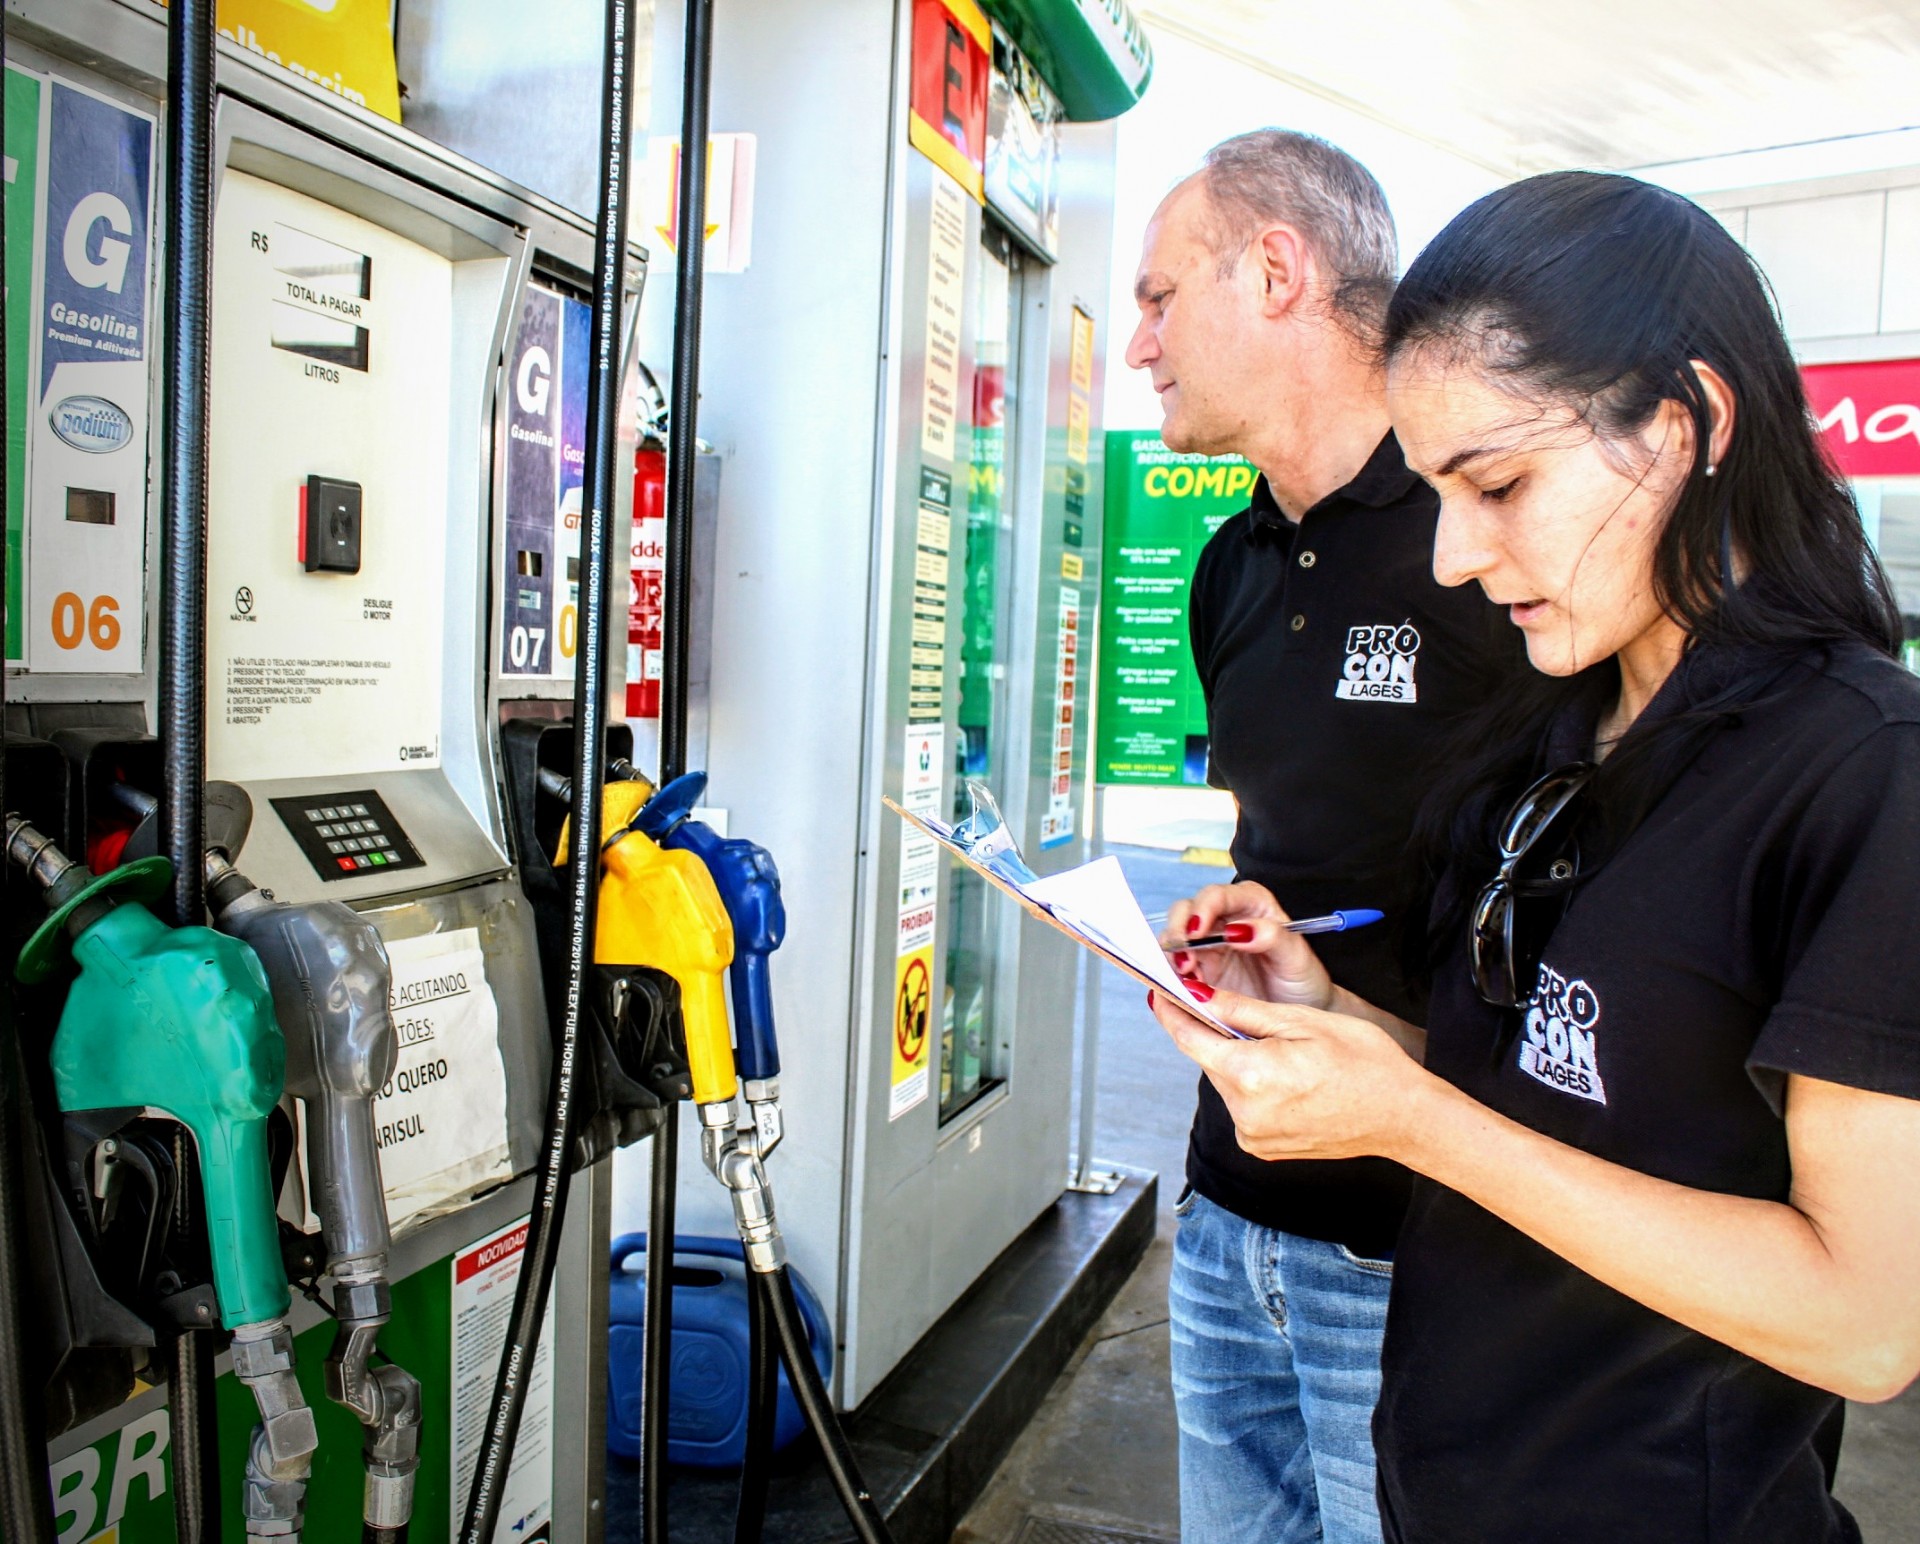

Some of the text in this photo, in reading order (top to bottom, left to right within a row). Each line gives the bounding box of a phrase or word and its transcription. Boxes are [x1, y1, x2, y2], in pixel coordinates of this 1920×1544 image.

[614, 6, 625, 39] DIMEL
[612, 76, 622, 89] de
[611, 91, 622, 144] 24/10/2012
[609, 151, 620, 179] FLEX
[608, 181, 618, 208] FUEL
[606, 211, 617, 241] HOSE
[63, 192, 132, 294] G
[251, 232, 269, 253] R$
[603, 265, 614, 287] POL
[286, 282, 362, 318] TOTAL A PAGAR
[50, 302, 138, 341] Gasolina
[601, 315, 612, 332] MM
[48, 328, 141, 359] Premium Aditivada
[304, 363, 340, 384] LITROS
[517, 345, 551, 415] G
[511, 423, 554, 448] Gasolina
[564, 513, 582, 530] GT
[591, 509, 601, 553] KORAX
[631, 541, 663, 558] dde
[588, 562, 599, 602] KCOMB
[363, 598, 393, 609] DESLIGUE
[370, 611, 390, 620] MOTOR
[51, 591, 121, 651] 06
[558, 605, 577, 659] 0
[233, 657, 245, 666] NÃO
[247, 659, 265, 667] UTILIZE
[273, 659, 296, 667] TECLADO
[510, 626, 546, 668] 07
[585, 612, 597, 691] KARBURANTE
[233, 668, 263, 676] PRESSIONE
[283, 668, 306, 676] TECLADO
[233, 678, 263, 686] PRESSIONE
[1343, 652, 1416, 684] CON
[227, 687, 241, 695] PARA
[243, 686, 294, 696] PREDETERMINAÇÃO
[233, 697, 250, 705] DIGITE
[289, 696, 312, 704] TECLADO
[1350, 684, 1404, 698] LAGES
[233, 706, 263, 714] PRESSIONE
[233, 716, 261, 725] ABASTEÇA
[582, 703, 594, 759] PORTARIA
[578, 823, 589, 859] DIMEL
[575, 877, 587, 897] 198
[574, 899, 584, 913] de
[901, 909, 933, 934] PROIBIDA
[571, 914, 584, 971] 24/10/2012
[400, 972, 467, 1003] ACEITANDO
[567, 980, 579, 1009] FLEX
[398, 1017, 434, 1043] TÕES:
[565, 1011, 577, 1041] FUEL
[1526, 1007, 1596, 1072] CON
[561, 1042, 574, 1075] HOSE
[1535, 1049, 1592, 1094] LAGES
[398, 1058, 448, 1094] QUERO
[376, 1114, 425, 1149] NRISUL
[552, 1136, 563, 1147] 19
[550, 1150, 561, 1168] MM
[543, 1196, 552, 1208] 16
[478, 1227, 529, 1268] NOCIVIDAD
[505, 1344, 522, 1389] KORAX
[493, 1395, 512, 1435] KCOMB
[49, 1409, 171, 1544] BR
[474, 1445, 500, 1519] KARBURANTE
[467, 1529, 479, 1544] PO
